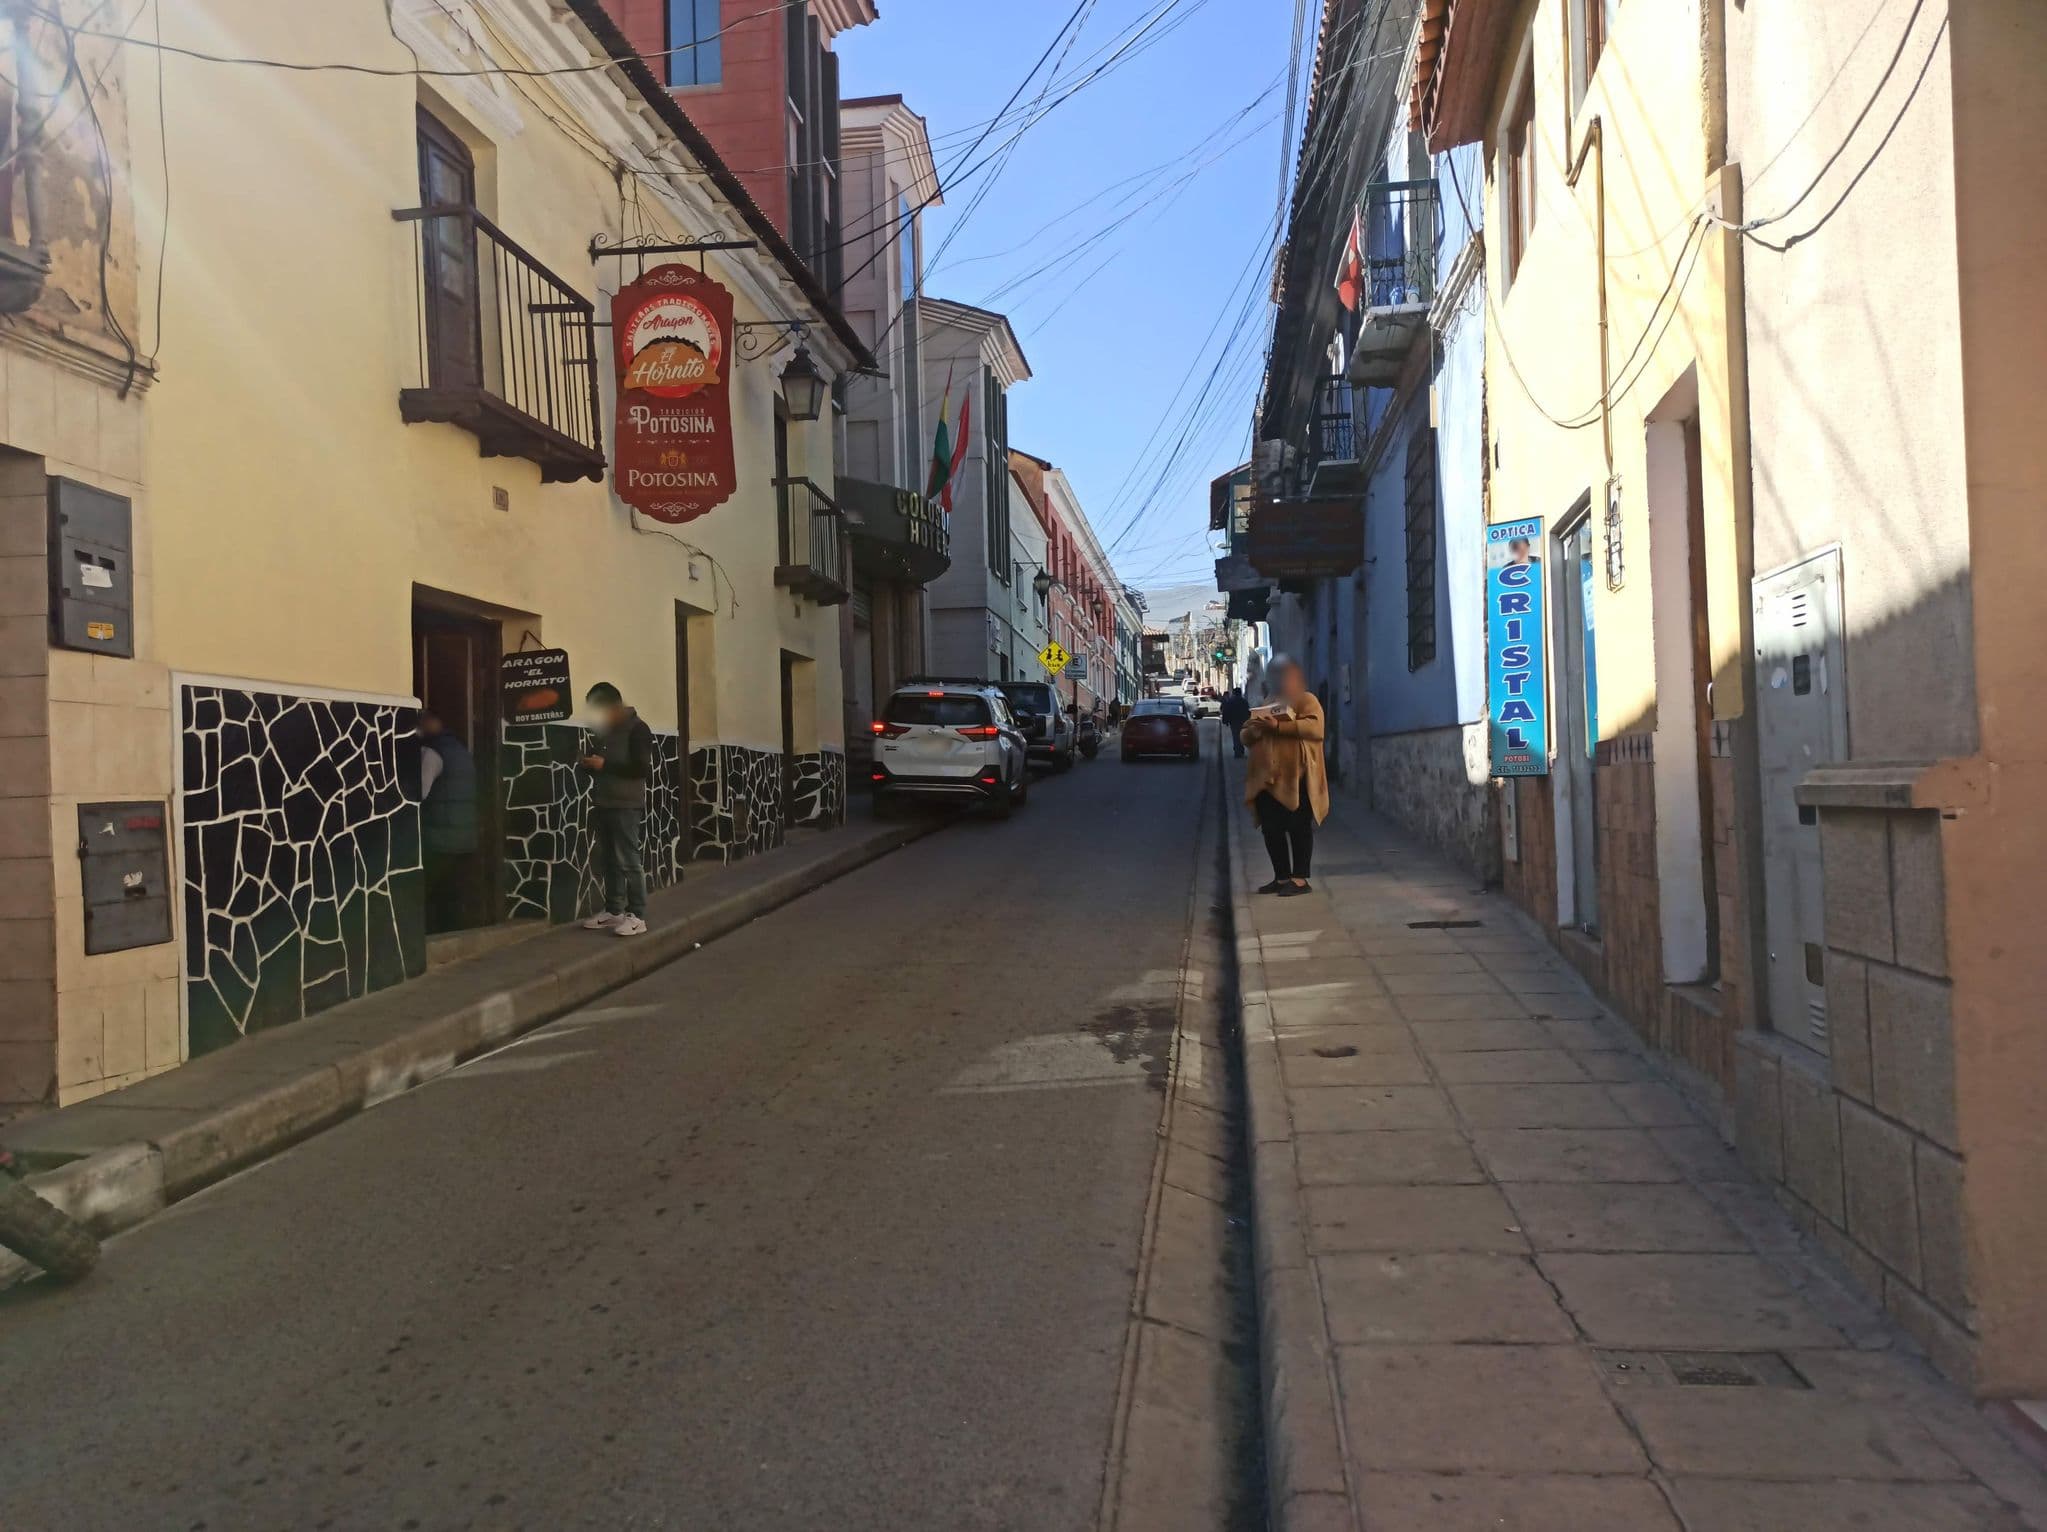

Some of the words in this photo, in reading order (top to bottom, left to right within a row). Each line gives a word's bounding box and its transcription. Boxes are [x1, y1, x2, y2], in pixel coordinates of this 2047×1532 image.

[643, 314, 694, 331] Aragon
[633, 358, 705, 386] Hornito
[629, 405, 715, 434] POTOSINA
[628, 469, 718, 487] POTOSINA
[1490, 523, 1536, 541] OPTICA
[502, 654, 564, 668] ARAGON
[1497, 563, 1536, 750] CRISTAL
